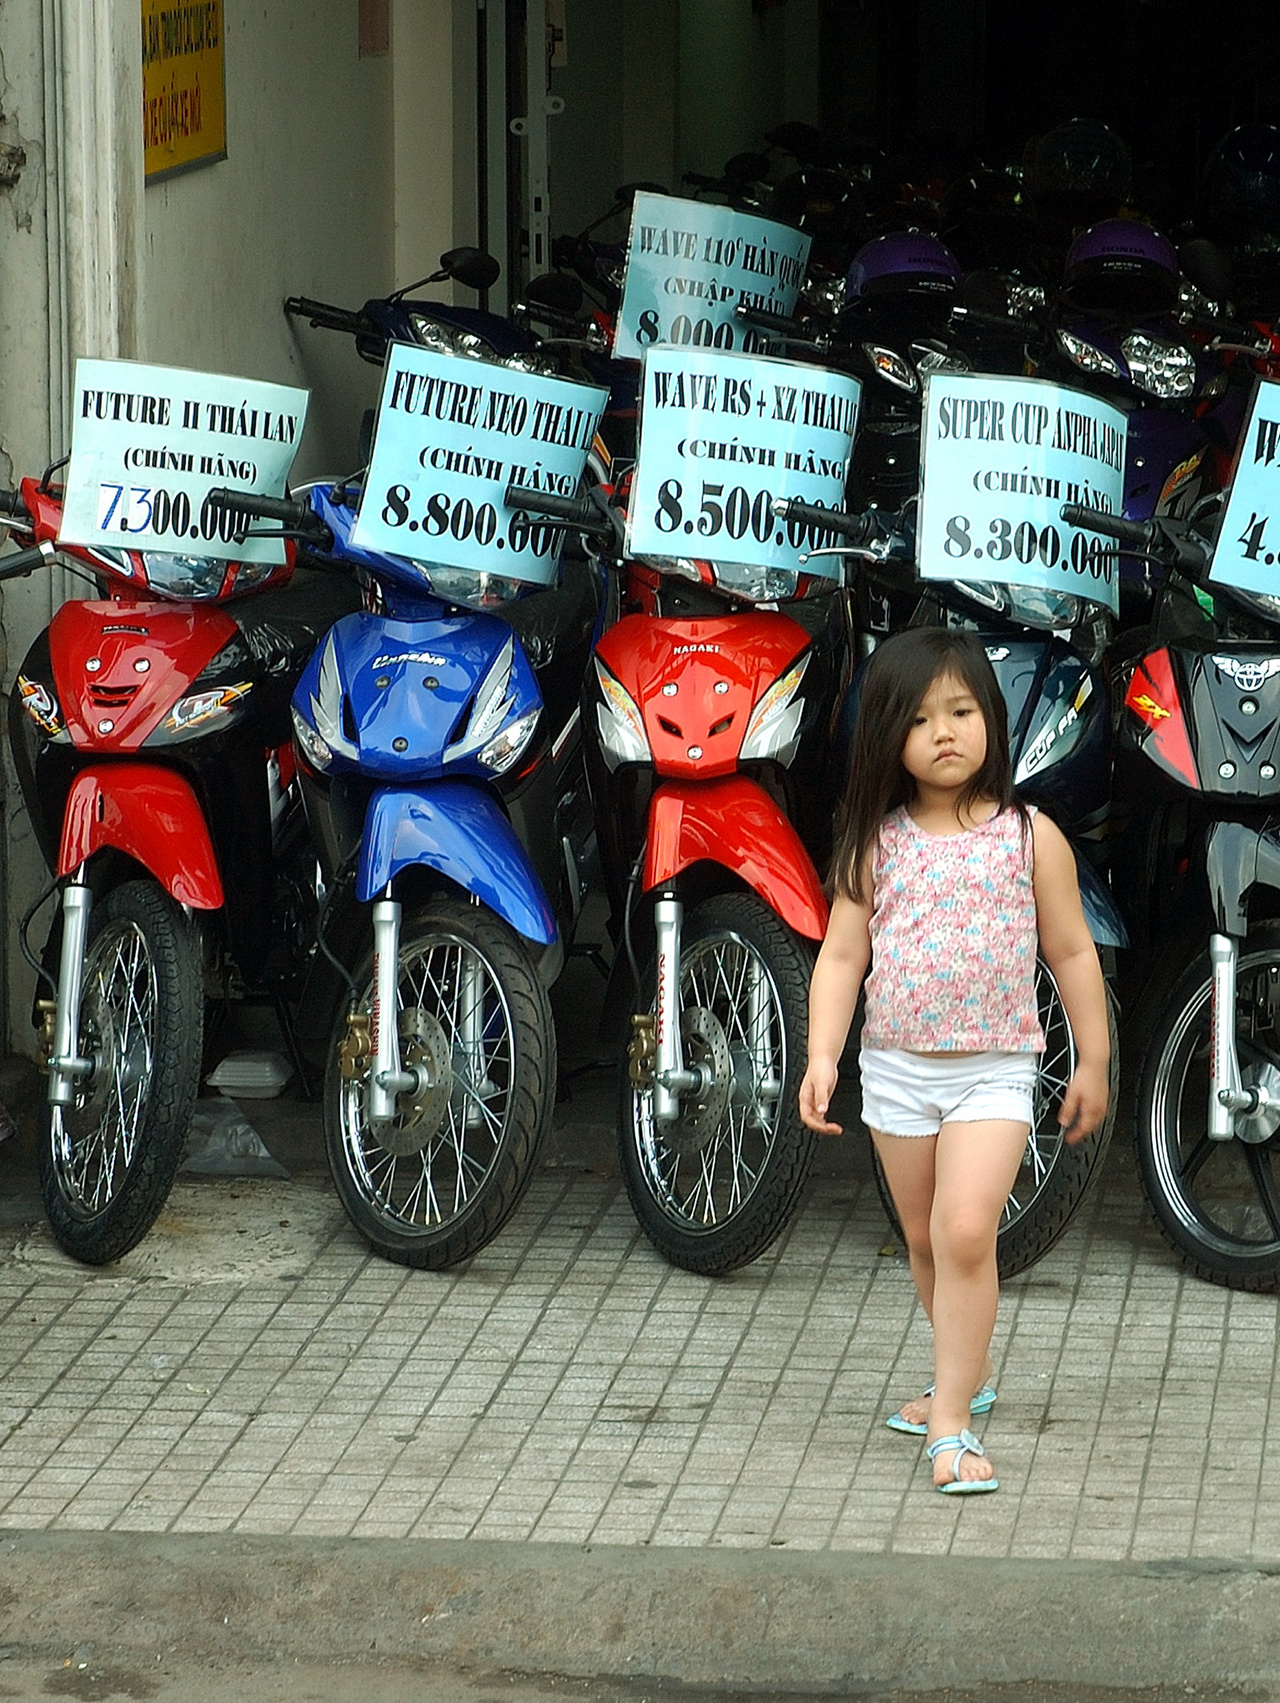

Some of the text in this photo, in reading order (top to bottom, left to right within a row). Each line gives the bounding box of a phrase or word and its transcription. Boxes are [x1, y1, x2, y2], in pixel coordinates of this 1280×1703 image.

[640, 226, 697, 261] WAVE
[81, 389, 298, 444] FUTURE II THÁI LAN
[388, 370, 484, 429] FUTURE
[482, 390, 528, 437] NEO
[653, 371, 717, 413] WAVE
[722, 377, 752, 417] RS
[771, 384, 798, 423] XZ
[938, 396, 1005, 442] SUPER
[1011, 401, 1049, 446] CUP
[124, 446, 258, 486] (CHÍNH HÃNG)
[419, 446, 503, 481] (CHÍNH
[676, 436, 776, 468] (CHÍNH
[972, 466, 1061, 500] (CHÍNH
[943, 515, 1113, 585] 8.300.000
[1026, 728, 1057, 773] CUP
